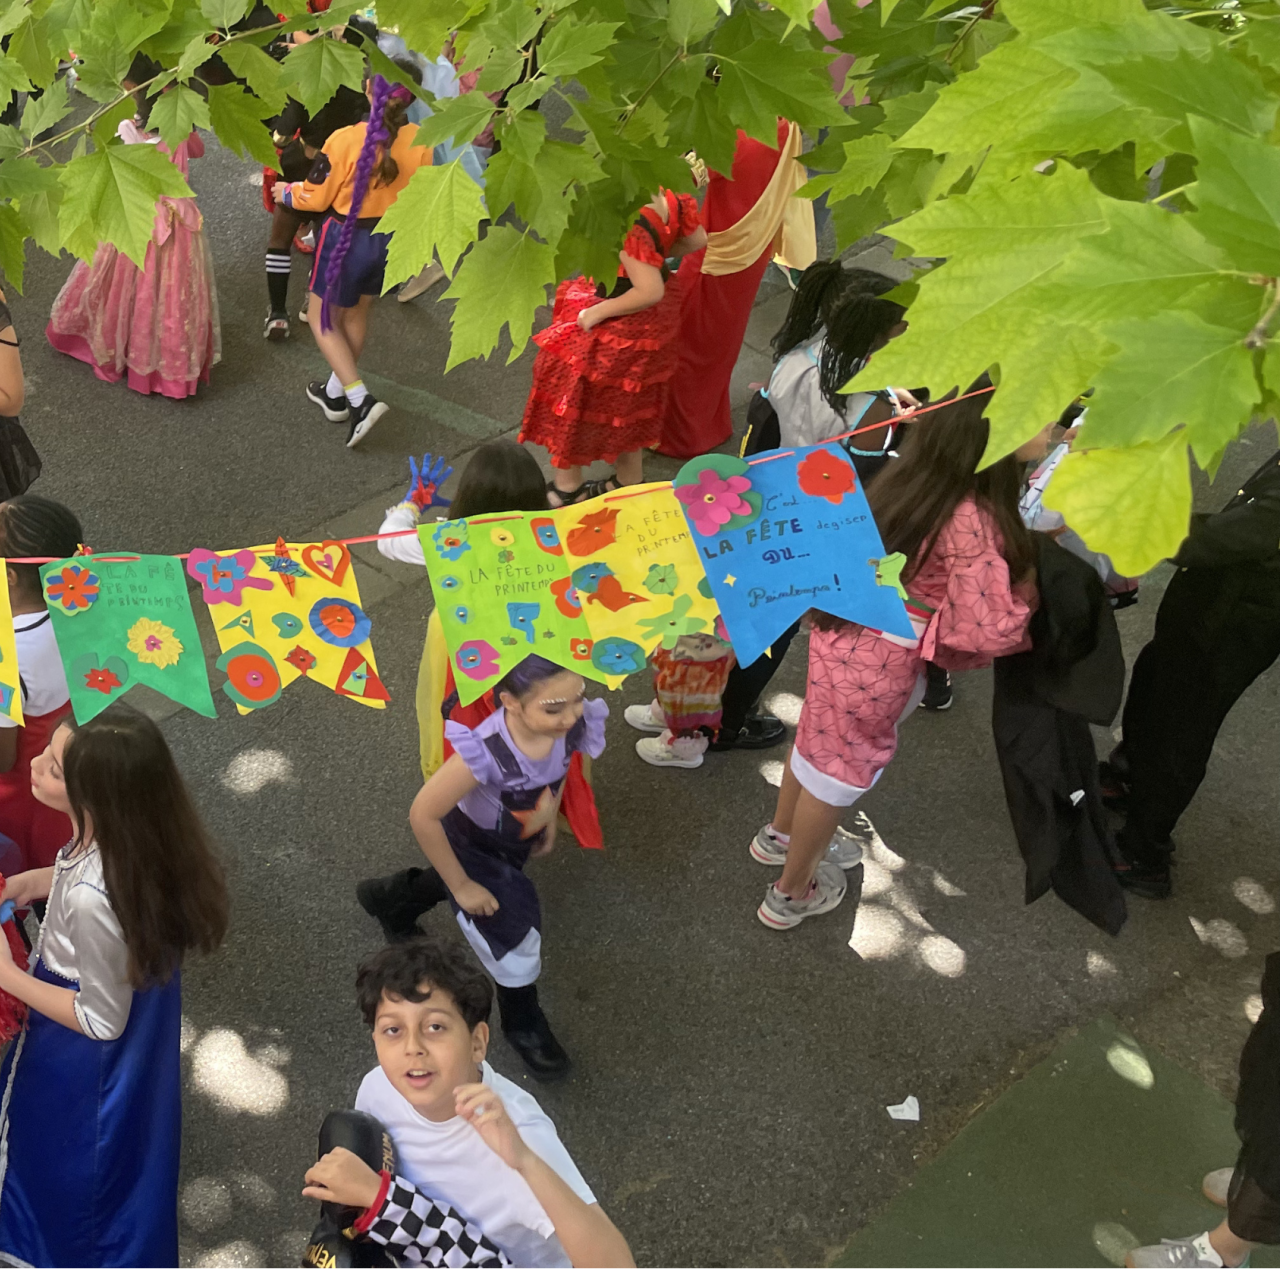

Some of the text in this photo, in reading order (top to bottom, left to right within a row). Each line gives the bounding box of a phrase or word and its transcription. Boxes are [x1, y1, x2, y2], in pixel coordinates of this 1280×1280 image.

[643, 509, 681, 527] FÊTE
[703, 518, 803, 559] LA FÊTE
[106, 565, 137, 579] LA
[469, 563, 555, 585] LA FÊTE DU
